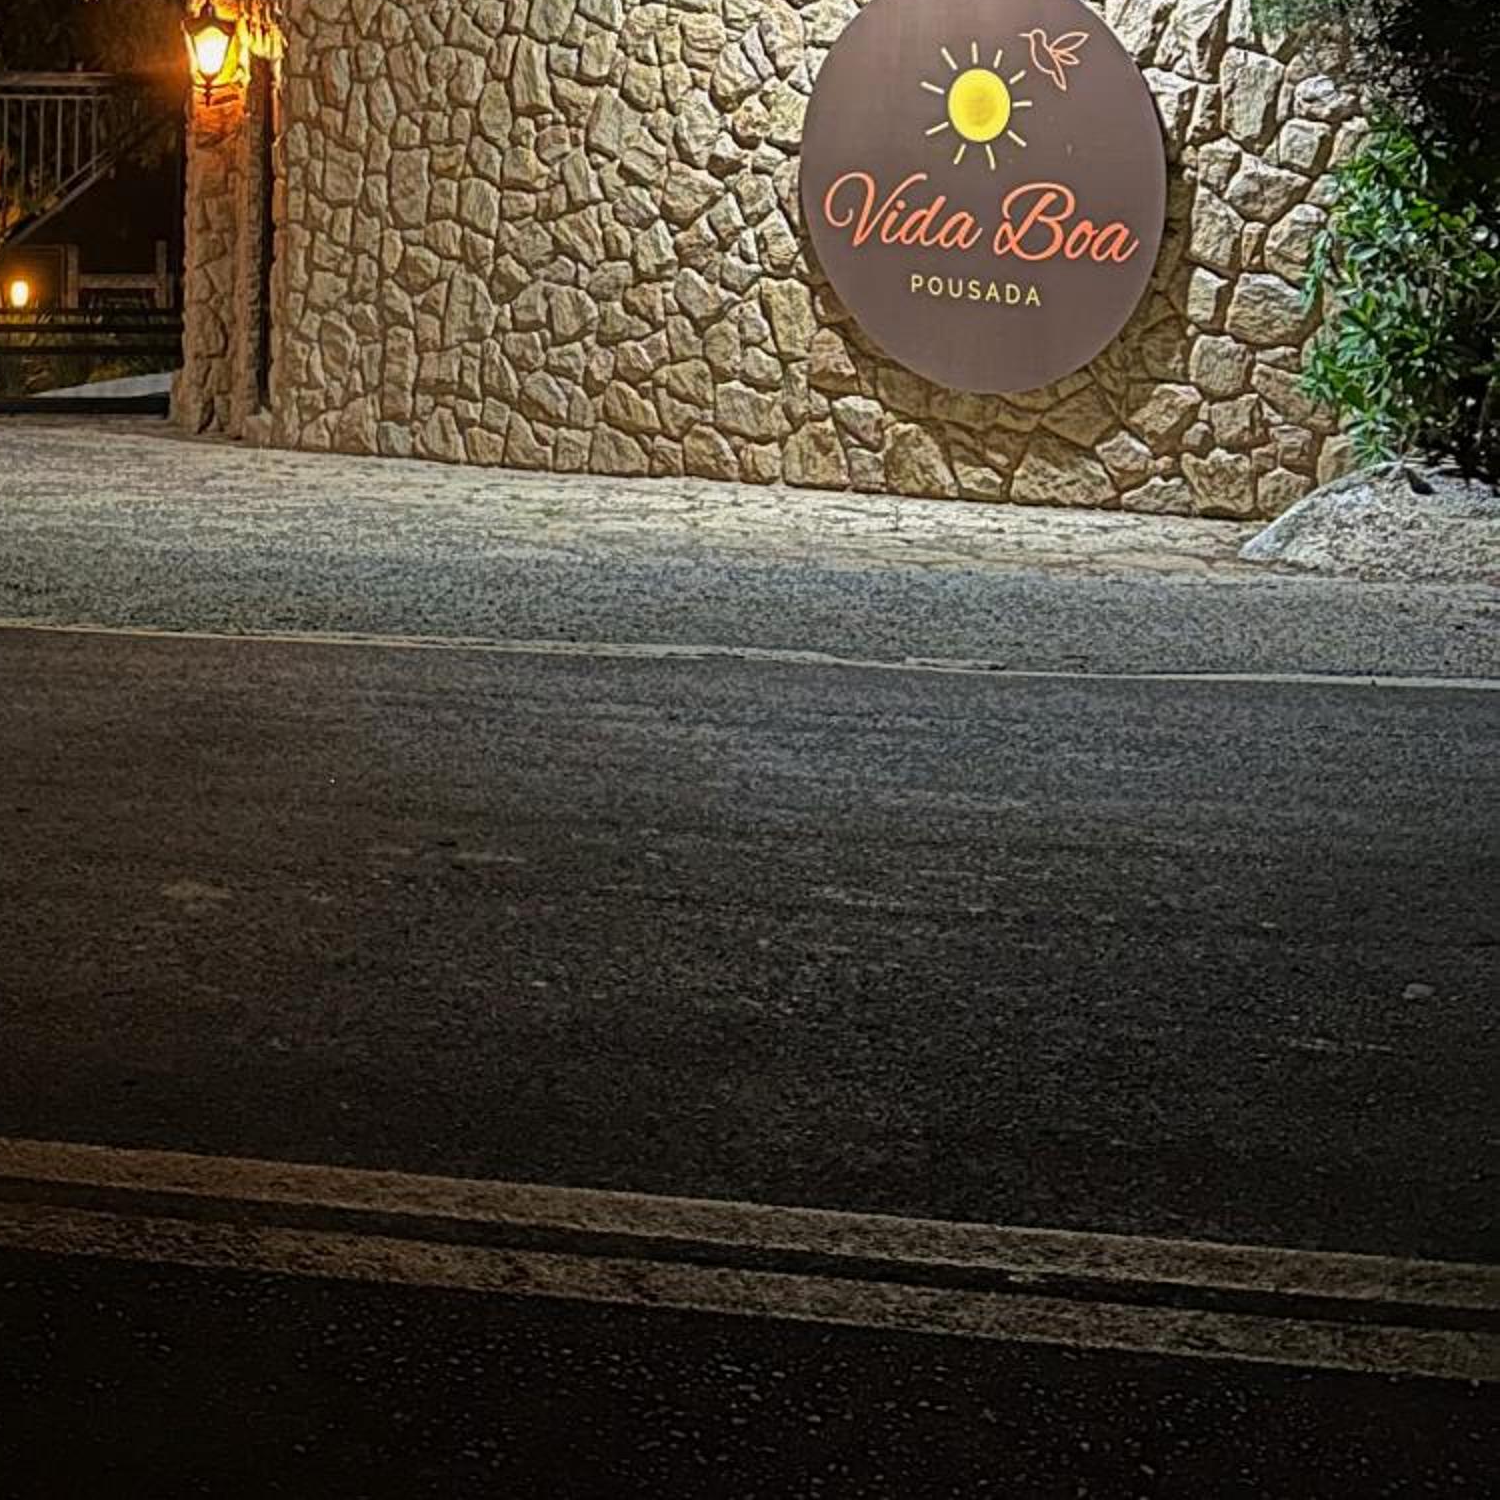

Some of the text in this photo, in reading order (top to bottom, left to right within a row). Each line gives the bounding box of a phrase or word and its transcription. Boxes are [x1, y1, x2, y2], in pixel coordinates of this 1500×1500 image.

[823, 171, 1140, 263] Vida Boa
[911, 274, 1042, 307] POUSADA
